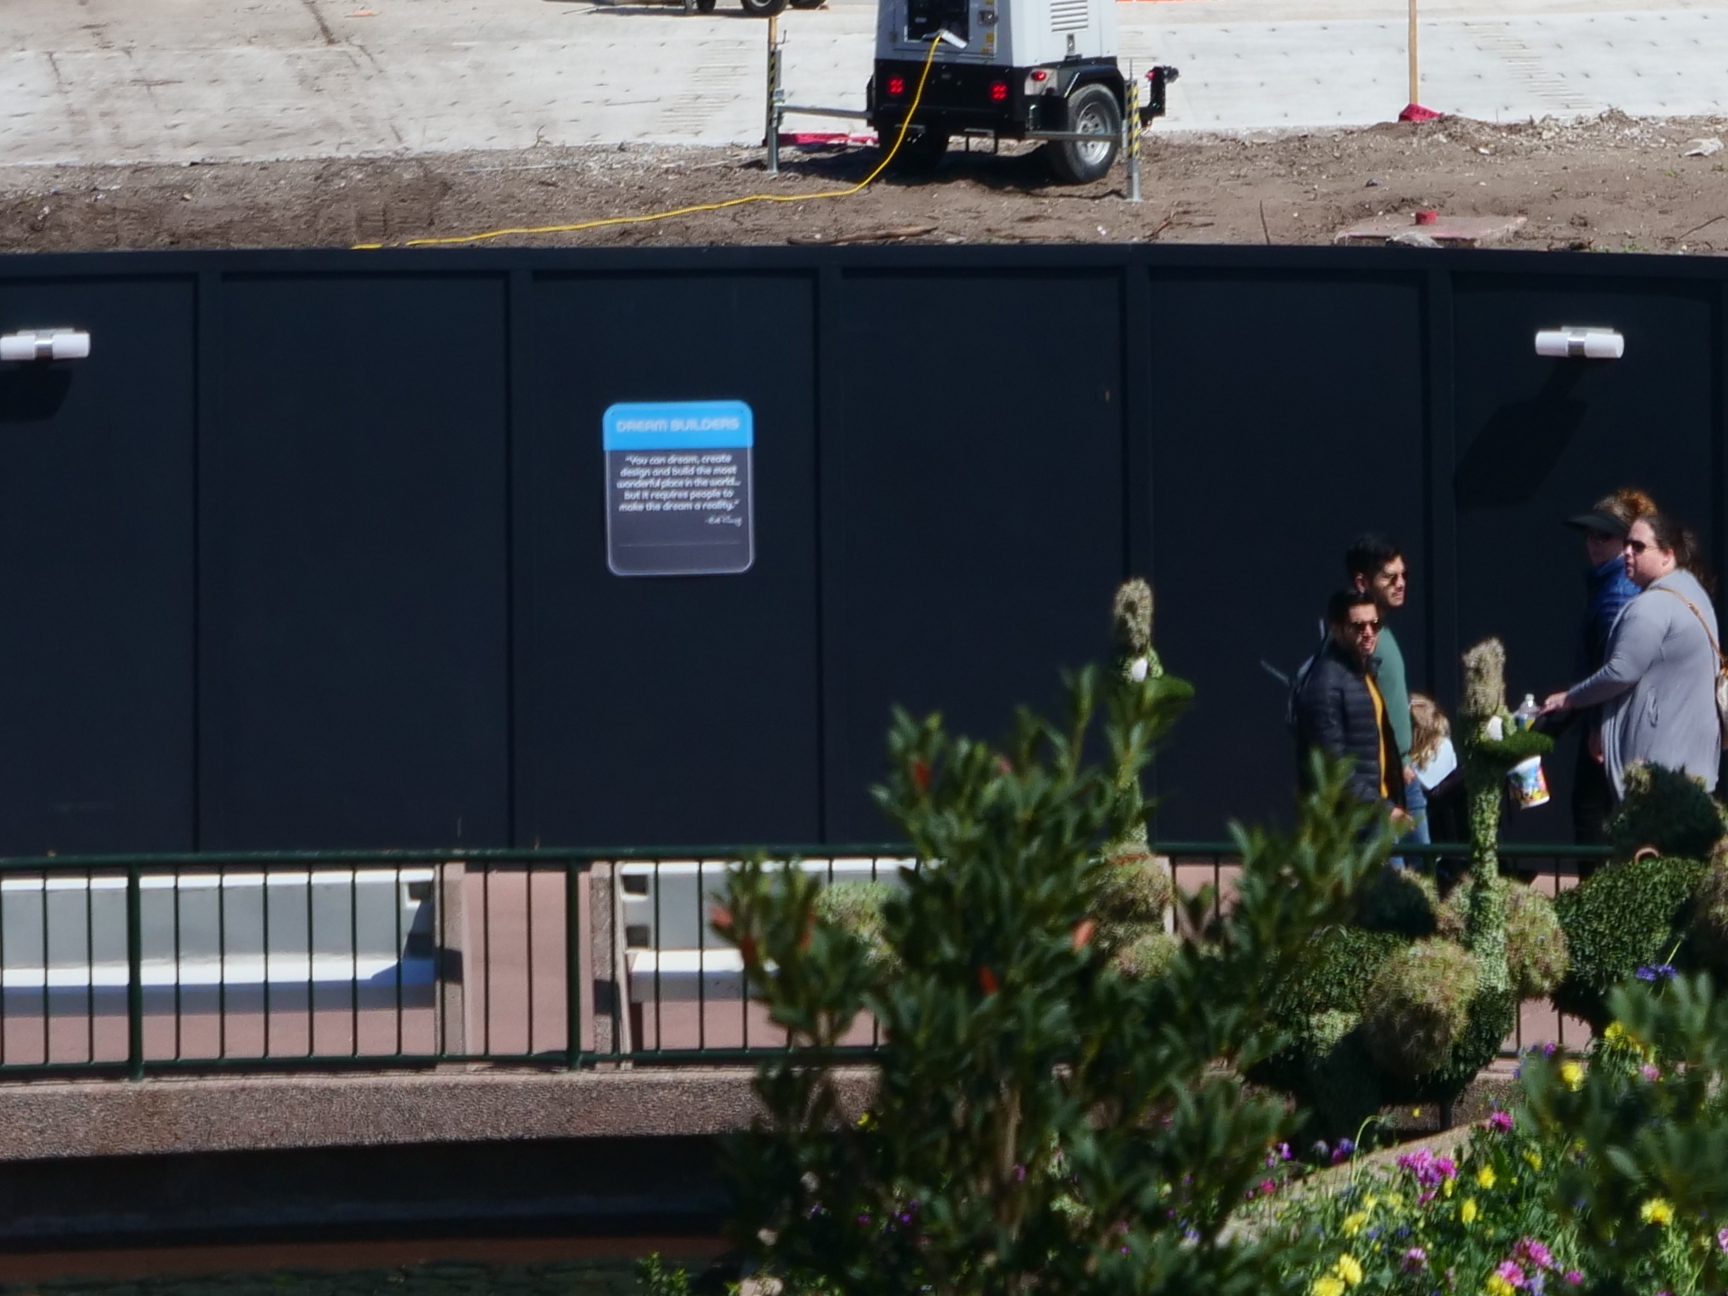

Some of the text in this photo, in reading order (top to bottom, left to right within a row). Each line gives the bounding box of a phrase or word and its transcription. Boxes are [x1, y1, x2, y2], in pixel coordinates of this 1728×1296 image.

[616, 417, 740, 432] DREAM BUILDERS
[649, 457, 666, 465] can
[667, 455, 700, 465] dream,
[620, 465, 737, 478] design and build the most
[616, 479, 660, 489] wonderful
[661, 478, 683, 489] place
[694, 478, 708, 487] the
[624, 491, 641, 500] but
[650, 490, 688, 501] requires
[689, 490, 720, 500] people
[723, 489, 734, 498] to
[619, 502, 644, 512] make
[645, 502, 660, 511] the
[662, 501, 693, 511] dream
